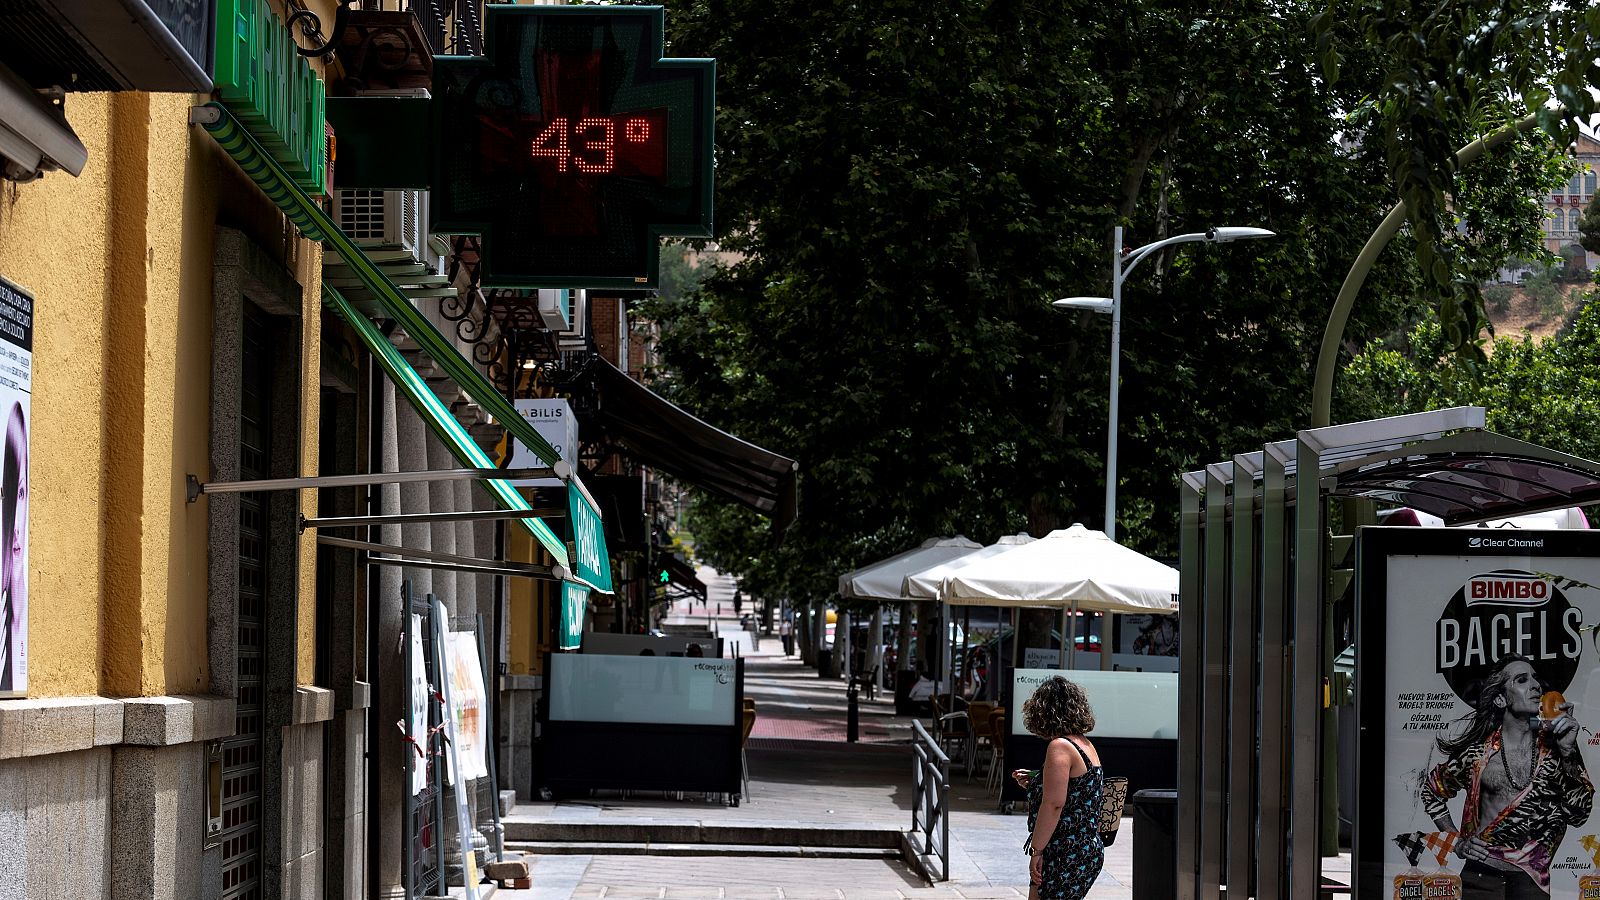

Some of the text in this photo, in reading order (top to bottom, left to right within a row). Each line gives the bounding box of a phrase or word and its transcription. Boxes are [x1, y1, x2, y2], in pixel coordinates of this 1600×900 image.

[1482, 538, 1544, 547] Clear Channel
[1471, 581, 1548, 599] BIMBO
[1440, 607, 1582, 669] BAGELS
[1398, 692, 1425, 700] NUEVOS
[1398, 701, 1455, 709] BAGELS BRIOCHE
[1410, 712, 1442, 721] GÓZALOS
[1402, 722, 1449, 730] A TU MANERA
[1428, 885, 1456, 897] BAGELS
